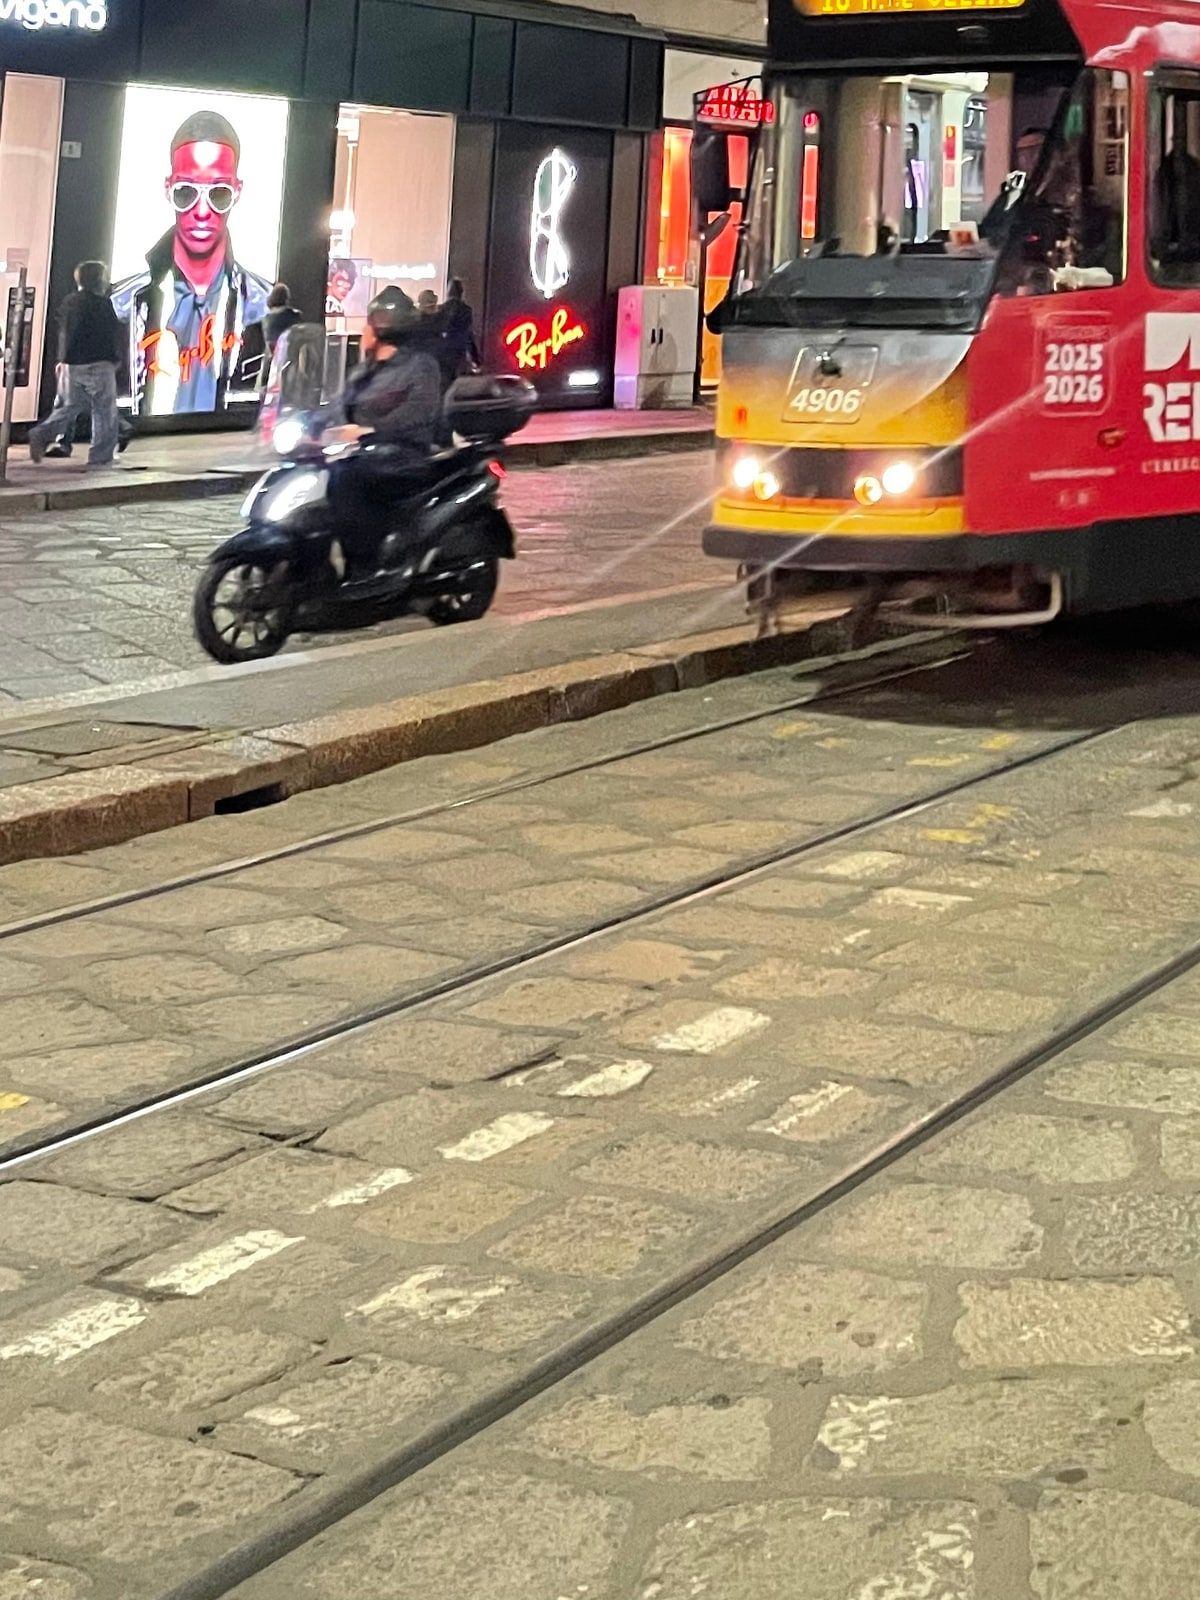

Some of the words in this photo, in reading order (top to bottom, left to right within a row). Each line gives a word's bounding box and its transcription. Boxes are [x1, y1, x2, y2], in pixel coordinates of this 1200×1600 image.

[1044, 342, 1104, 373] 2025
[789, 388, 862, 414] 4906
[1043, 374, 1104, 404] 2026
